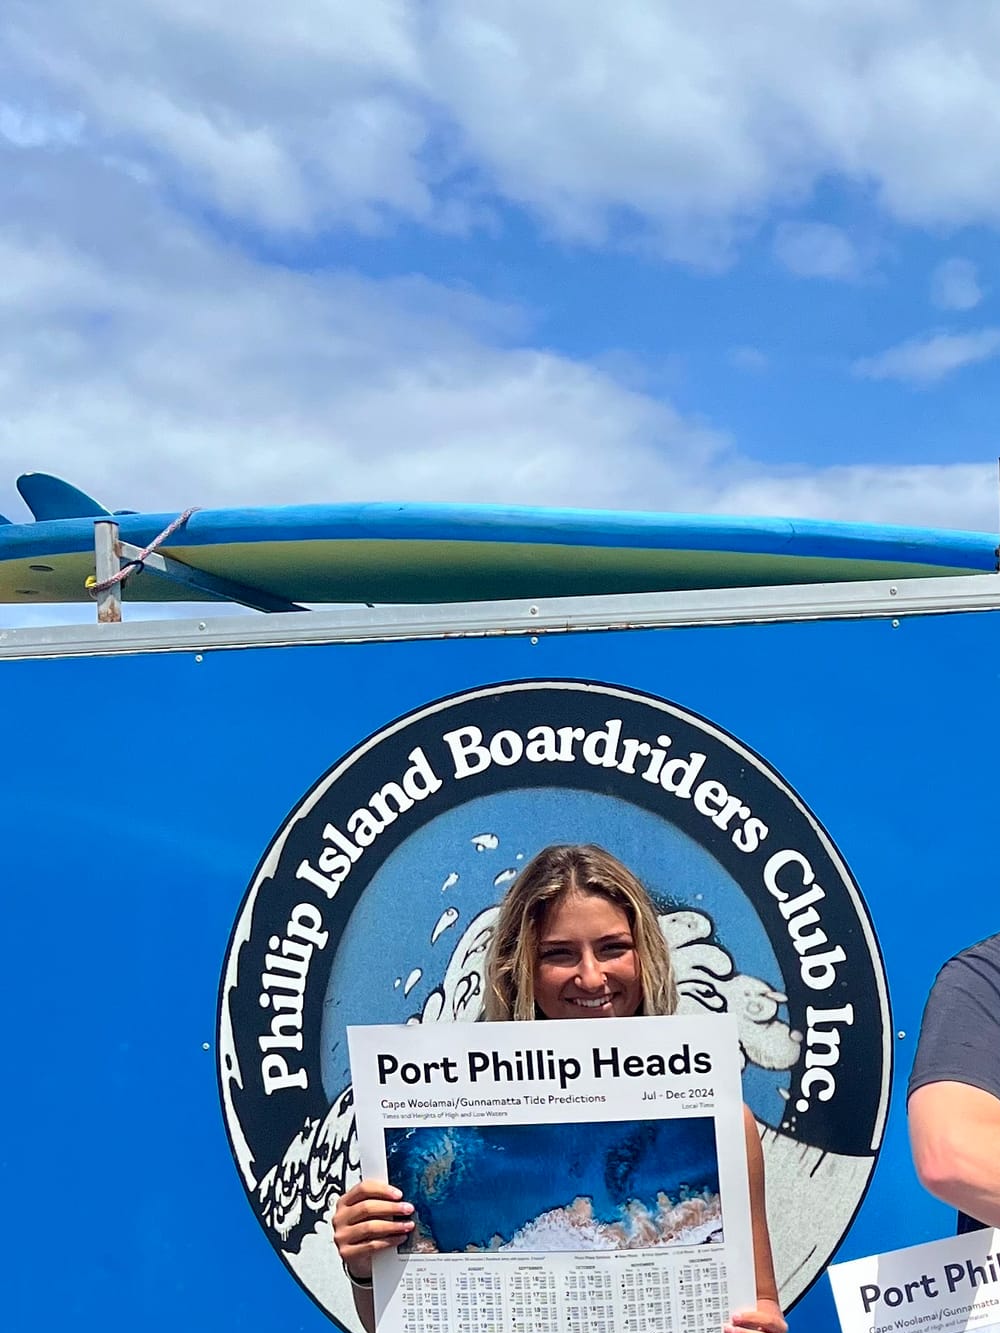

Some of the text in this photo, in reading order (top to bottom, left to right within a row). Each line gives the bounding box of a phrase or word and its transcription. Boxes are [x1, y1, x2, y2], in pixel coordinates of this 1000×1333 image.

[258, 719, 854, 1113] Phillip Island Boardriders Club Inc.
[377, 1044, 712, 1090] Port Phillip Heads
[380, 1094, 606, 1110] Cape Woolamai/Gunnamatta Tide Predictions
[642, 1091, 656, 1101] Jul
[666, 1090, 686, 1100] Dec
[688, 1088, 714, 1098] 2024
[860, 1274, 939, 1313] Port
[894, 1299, 999, 1329] Woolamai/Gunnamatta
